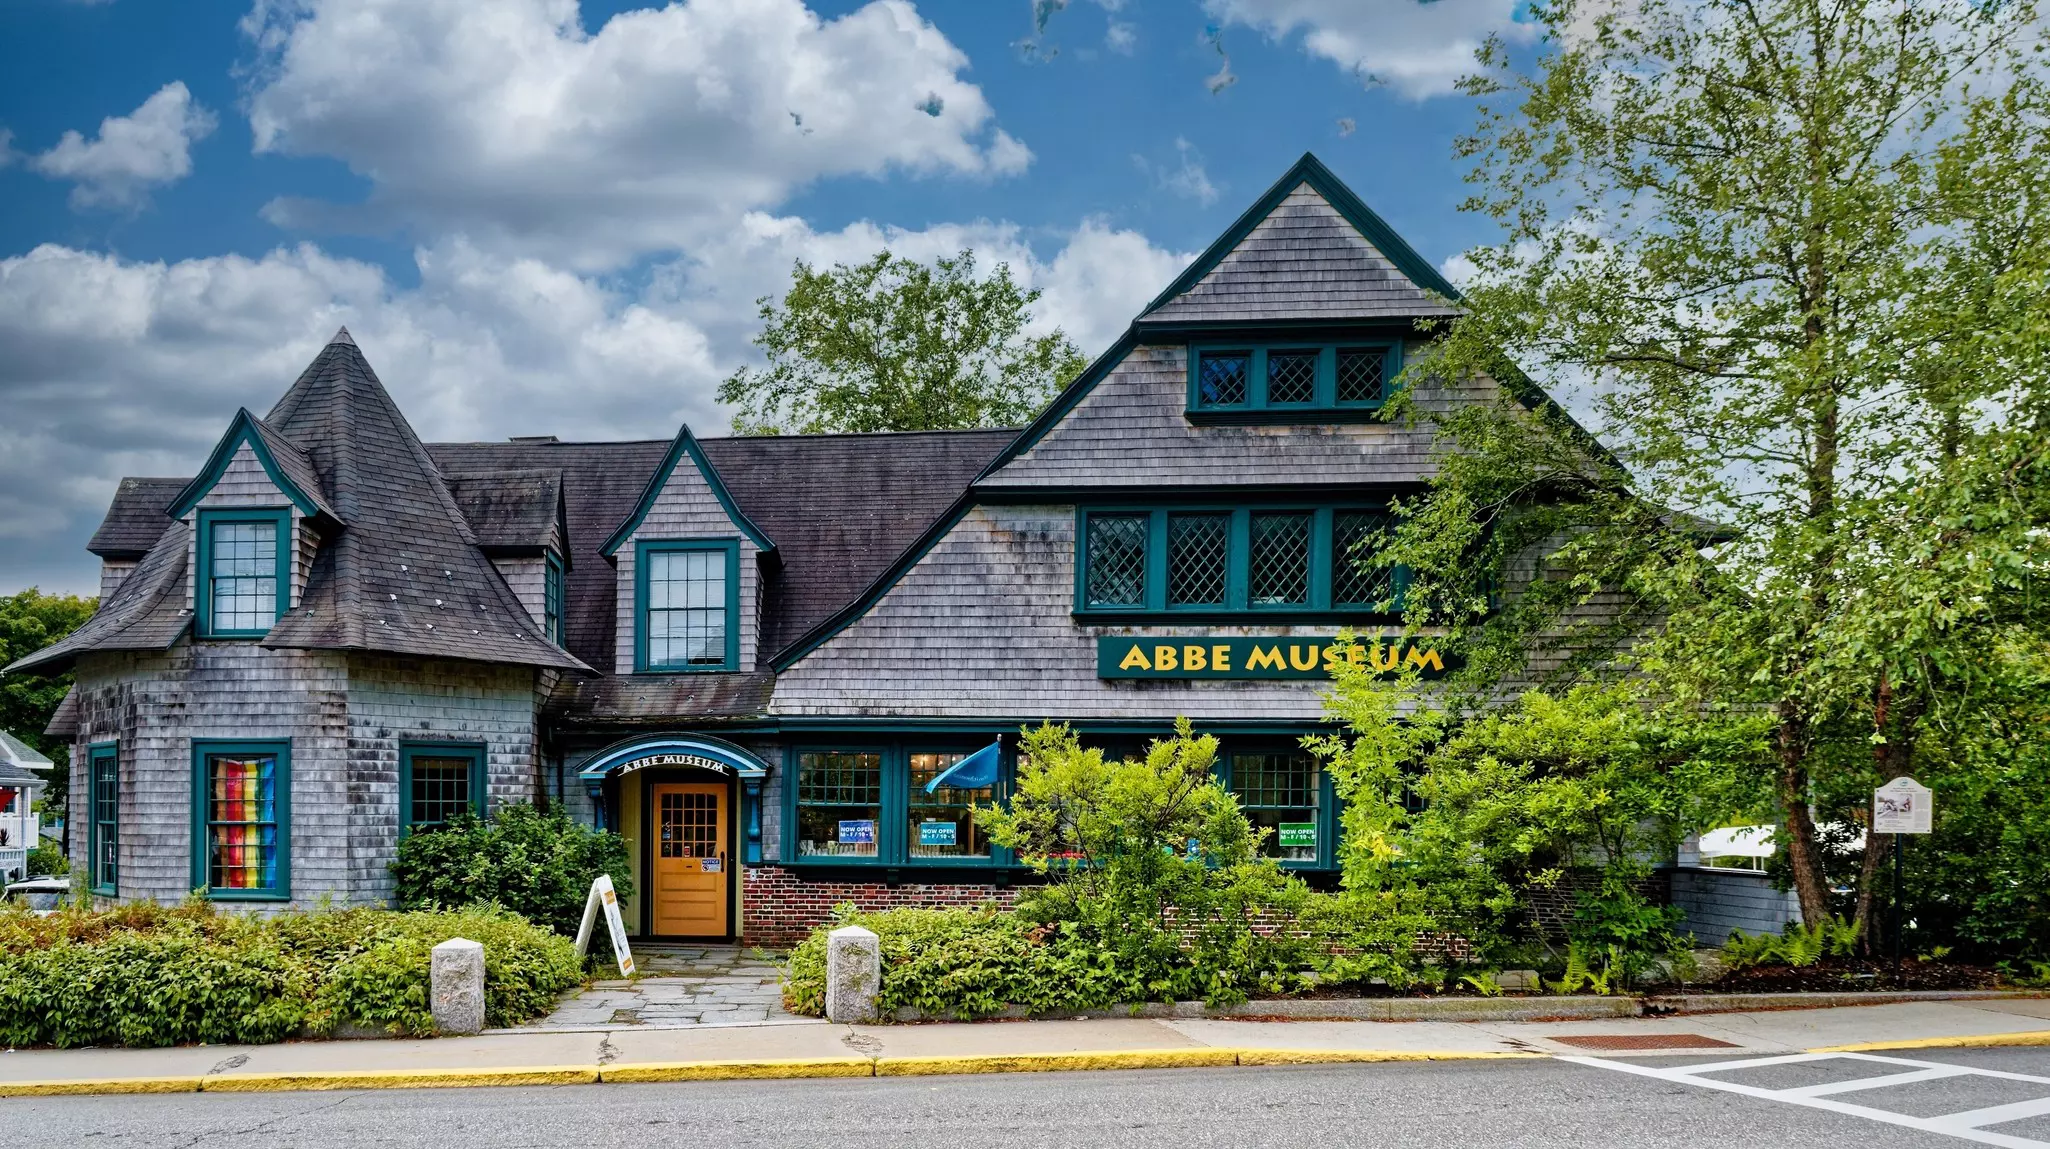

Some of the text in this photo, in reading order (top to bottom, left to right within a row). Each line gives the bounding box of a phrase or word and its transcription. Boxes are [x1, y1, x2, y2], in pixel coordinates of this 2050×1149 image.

[1119, 643, 1445, 672] ABBE MUSEUM
[622, 754, 724, 774] ABBE MUSEUM
